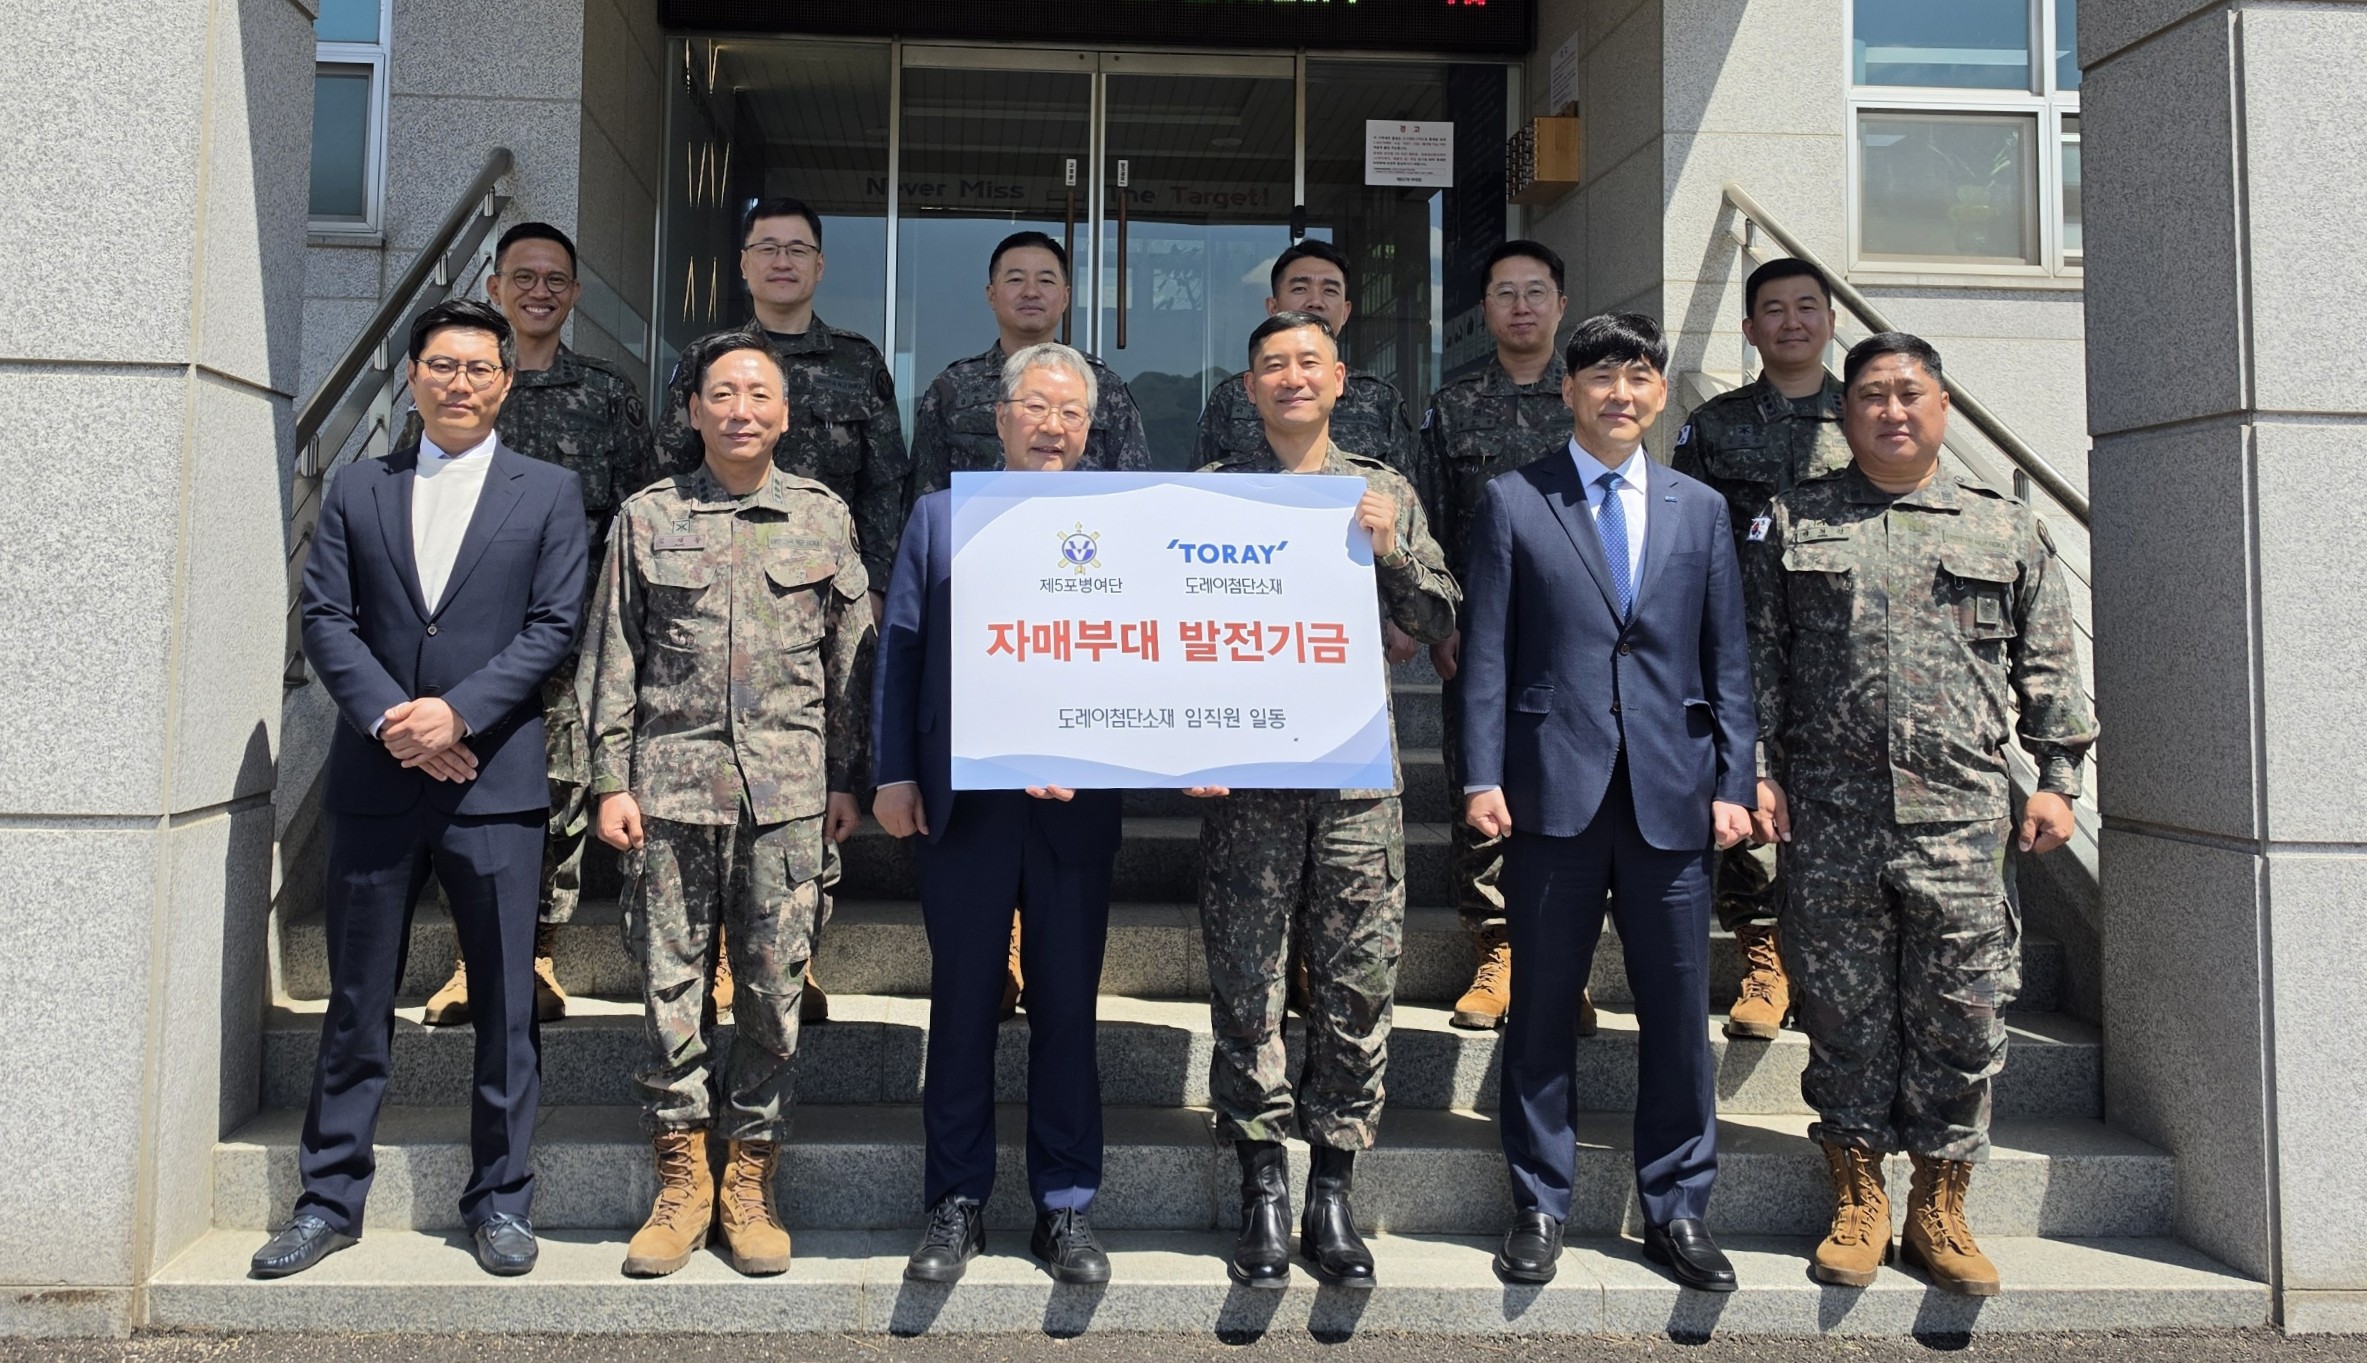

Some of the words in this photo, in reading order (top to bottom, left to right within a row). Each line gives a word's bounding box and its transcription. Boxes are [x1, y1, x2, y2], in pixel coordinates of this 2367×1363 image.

[866, 176, 947, 197] Nver
[958, 178, 1026, 200] Miss
[1039, 576, 1123, 594] 제5포병여단
[1185, 576, 1283, 596] 도레이첨단소재
[985, 619, 1160, 663] 자매부대
[1178, 620, 1350, 664] 발전기금
[1057, 707, 1175, 730] 도레이첨단소재
[1184, 707, 1241, 729] 임직원
[1249, 707, 1287, 730] 일동
